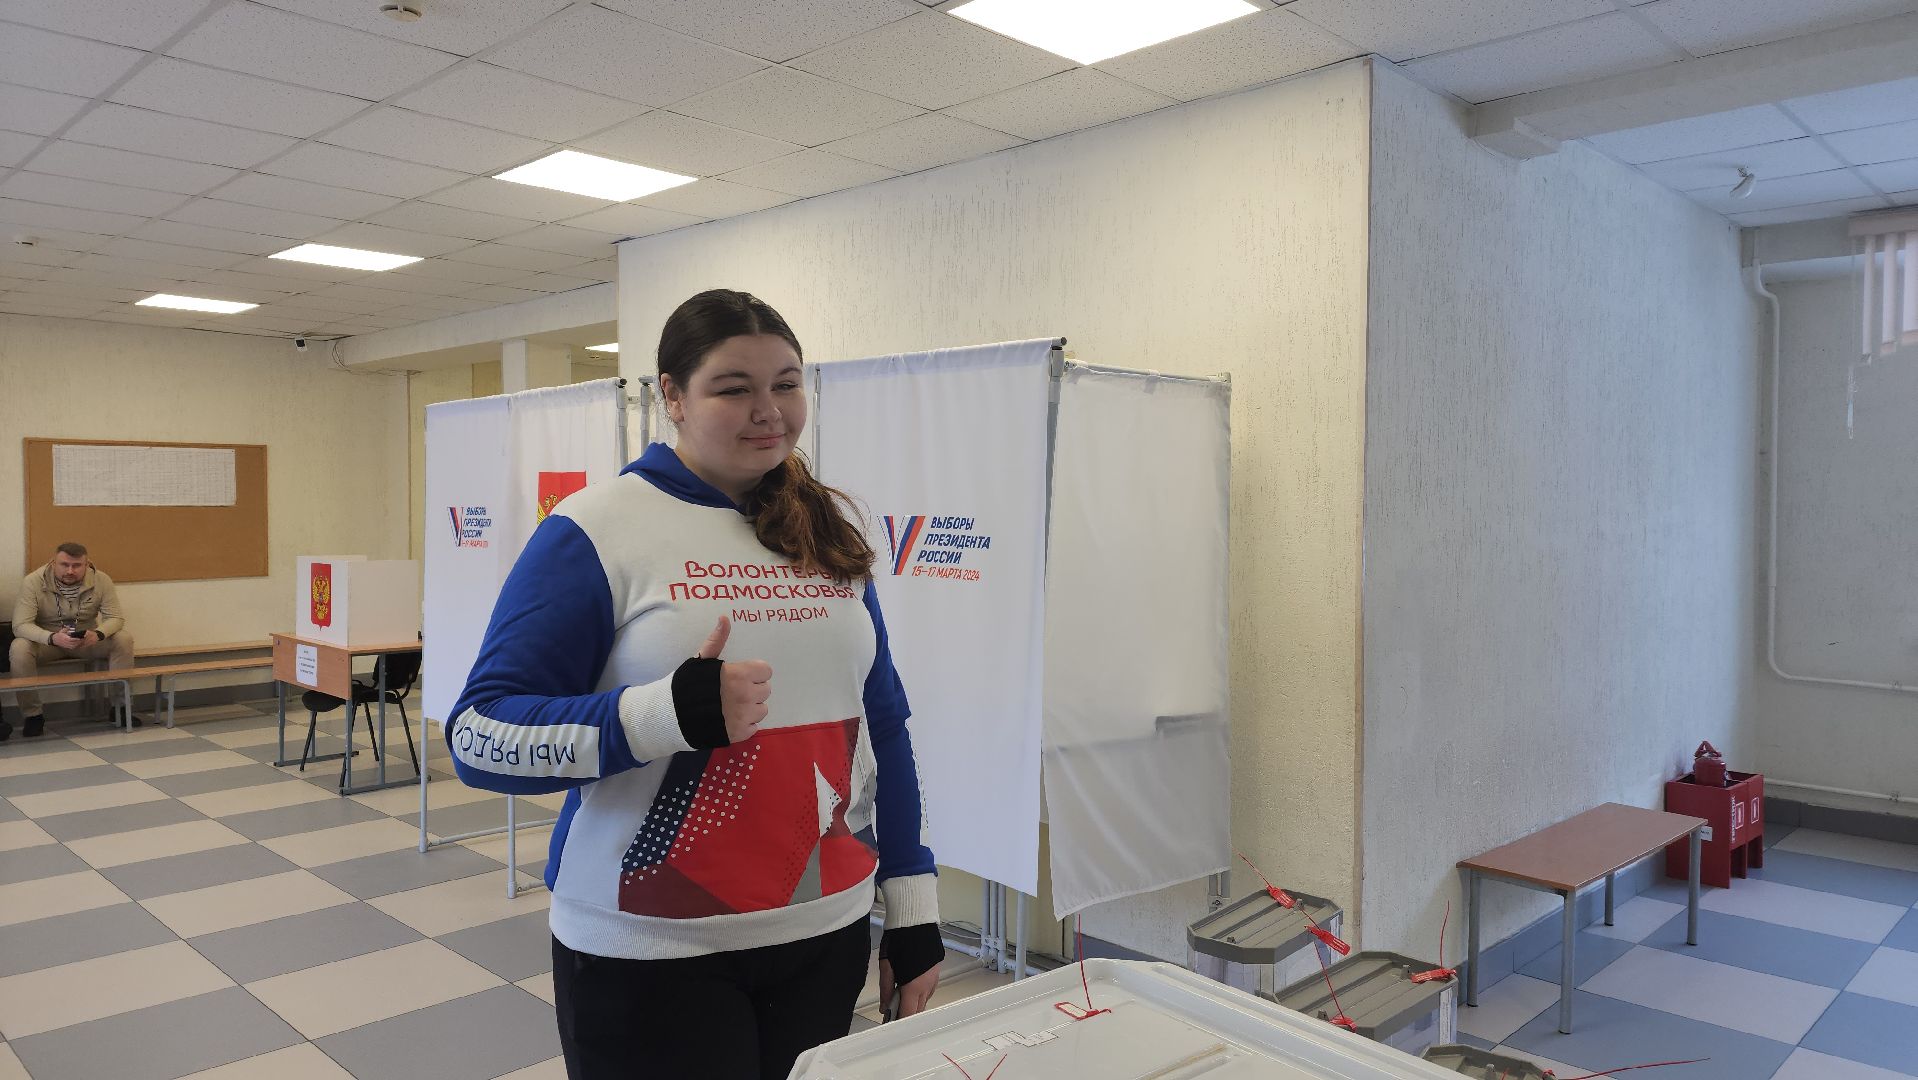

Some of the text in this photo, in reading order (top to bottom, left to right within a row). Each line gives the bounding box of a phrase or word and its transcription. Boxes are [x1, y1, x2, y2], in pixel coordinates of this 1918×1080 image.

[930, 516, 975, 531] ВЫБОРЫ
[924, 533, 991, 550] ПРЕЗИДЕНТА
[916, 549, 962, 565] РОССИИ
[937, 567, 962, 579] МАРТА
[963, 570, 980, 581] 2024
[732, 606, 829, 623] МЫ РЯДОМ
[456, 722, 577, 766] МЫ РЯДО
